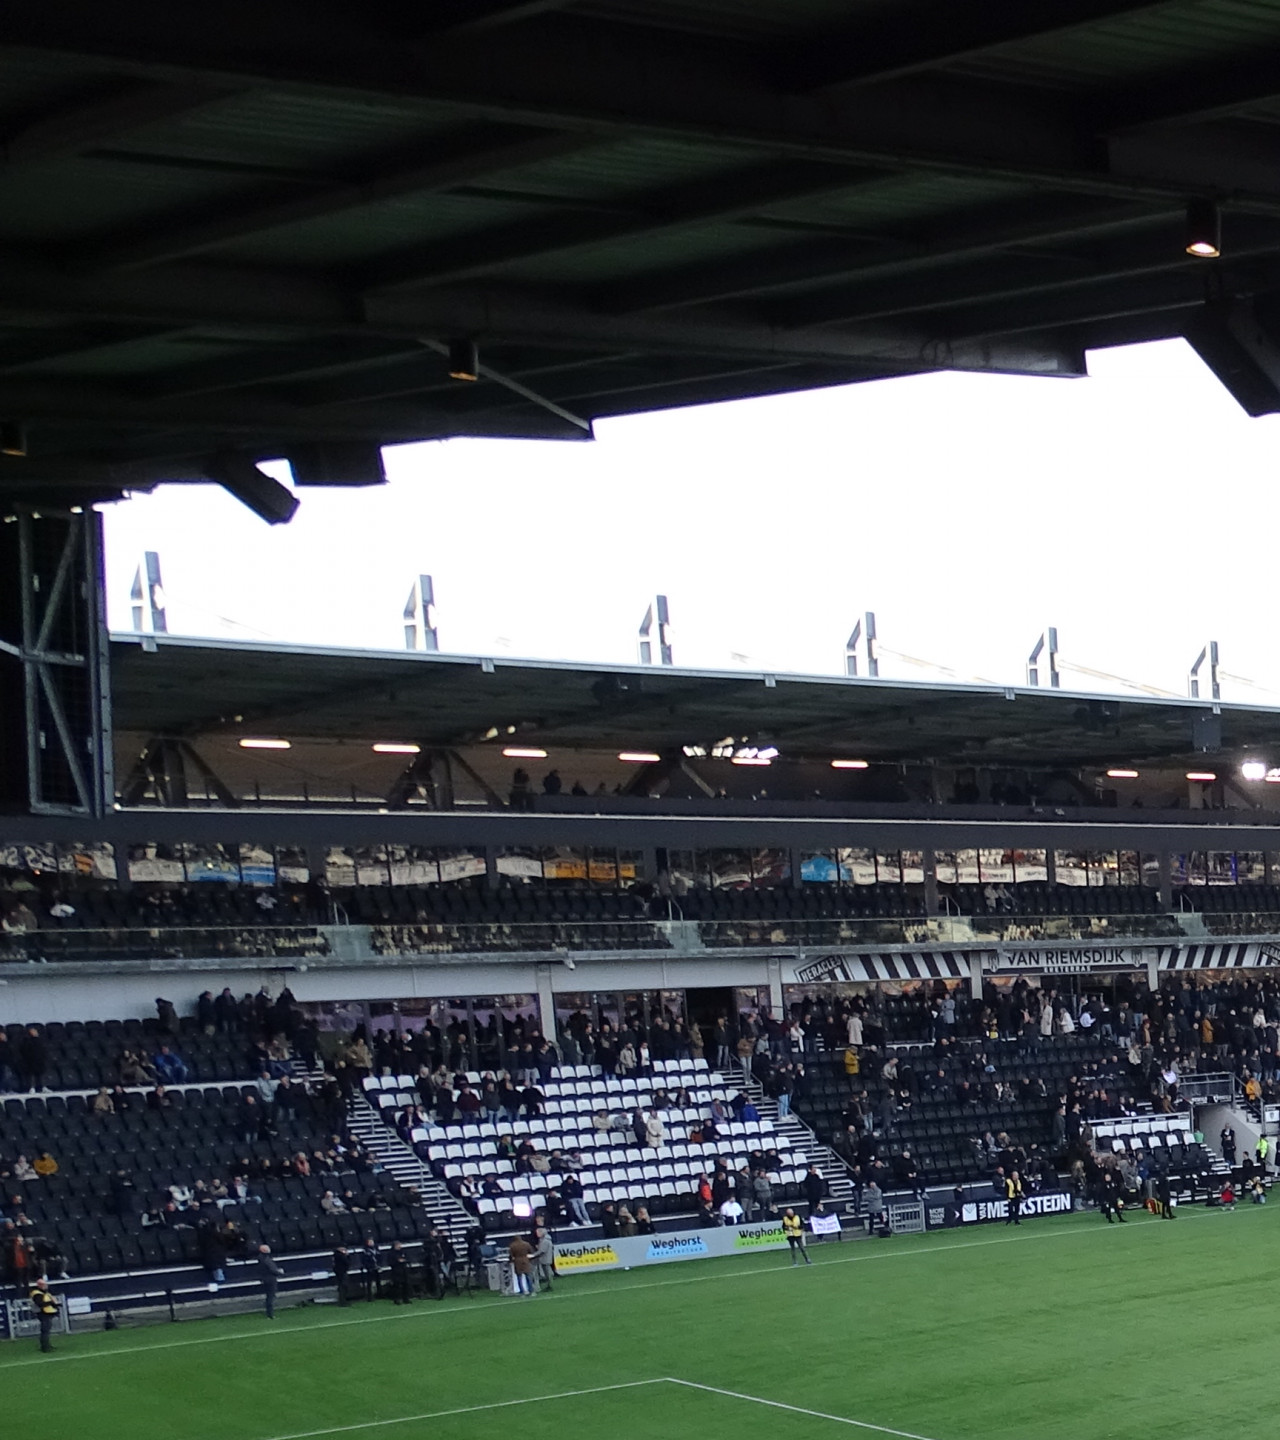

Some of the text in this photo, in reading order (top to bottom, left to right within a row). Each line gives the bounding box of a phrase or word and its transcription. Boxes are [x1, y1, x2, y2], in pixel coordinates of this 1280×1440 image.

[1008, 949, 1126, 966] VAN RIEMSDIJK
[987, 1193, 1071, 1219] MEKSTEIJN
[651, 1236, 702, 1250] Weghorst
[558, 1244, 612, 1258] Weghorst
